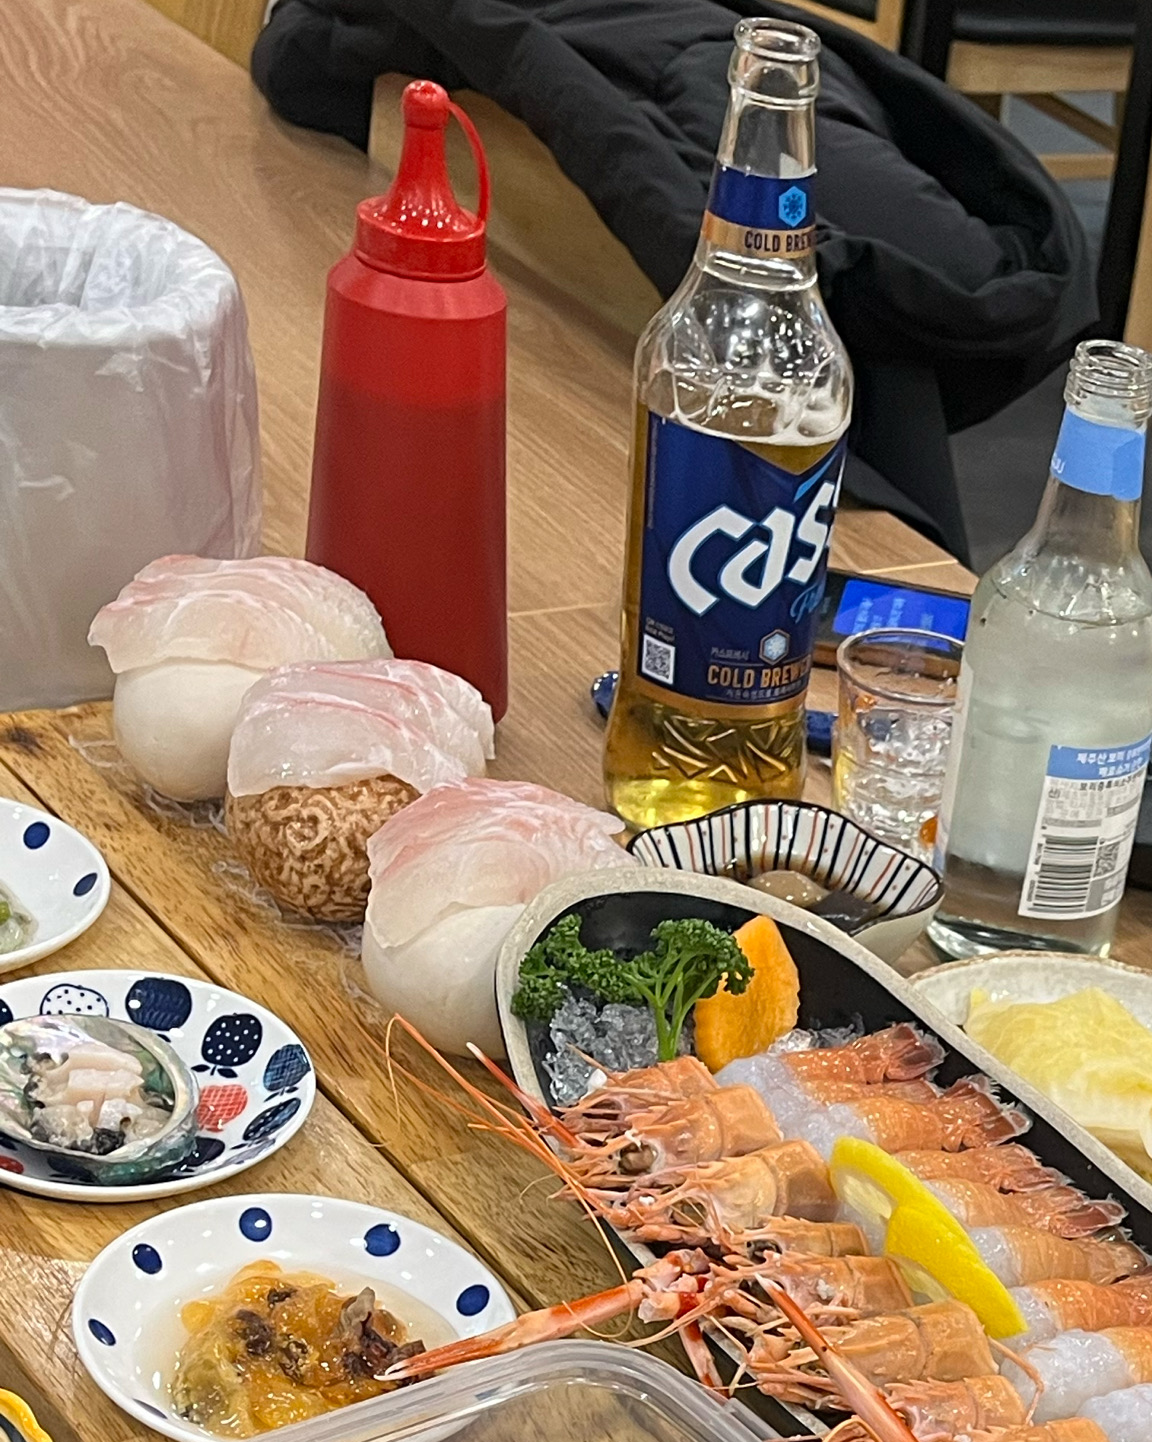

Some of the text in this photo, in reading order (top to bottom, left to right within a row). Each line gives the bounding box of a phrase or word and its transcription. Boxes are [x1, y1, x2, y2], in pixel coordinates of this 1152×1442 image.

[744, 230, 781, 253] COLD
[668, 455, 847, 616] Cas
[707, 664, 756, 689] COLD
